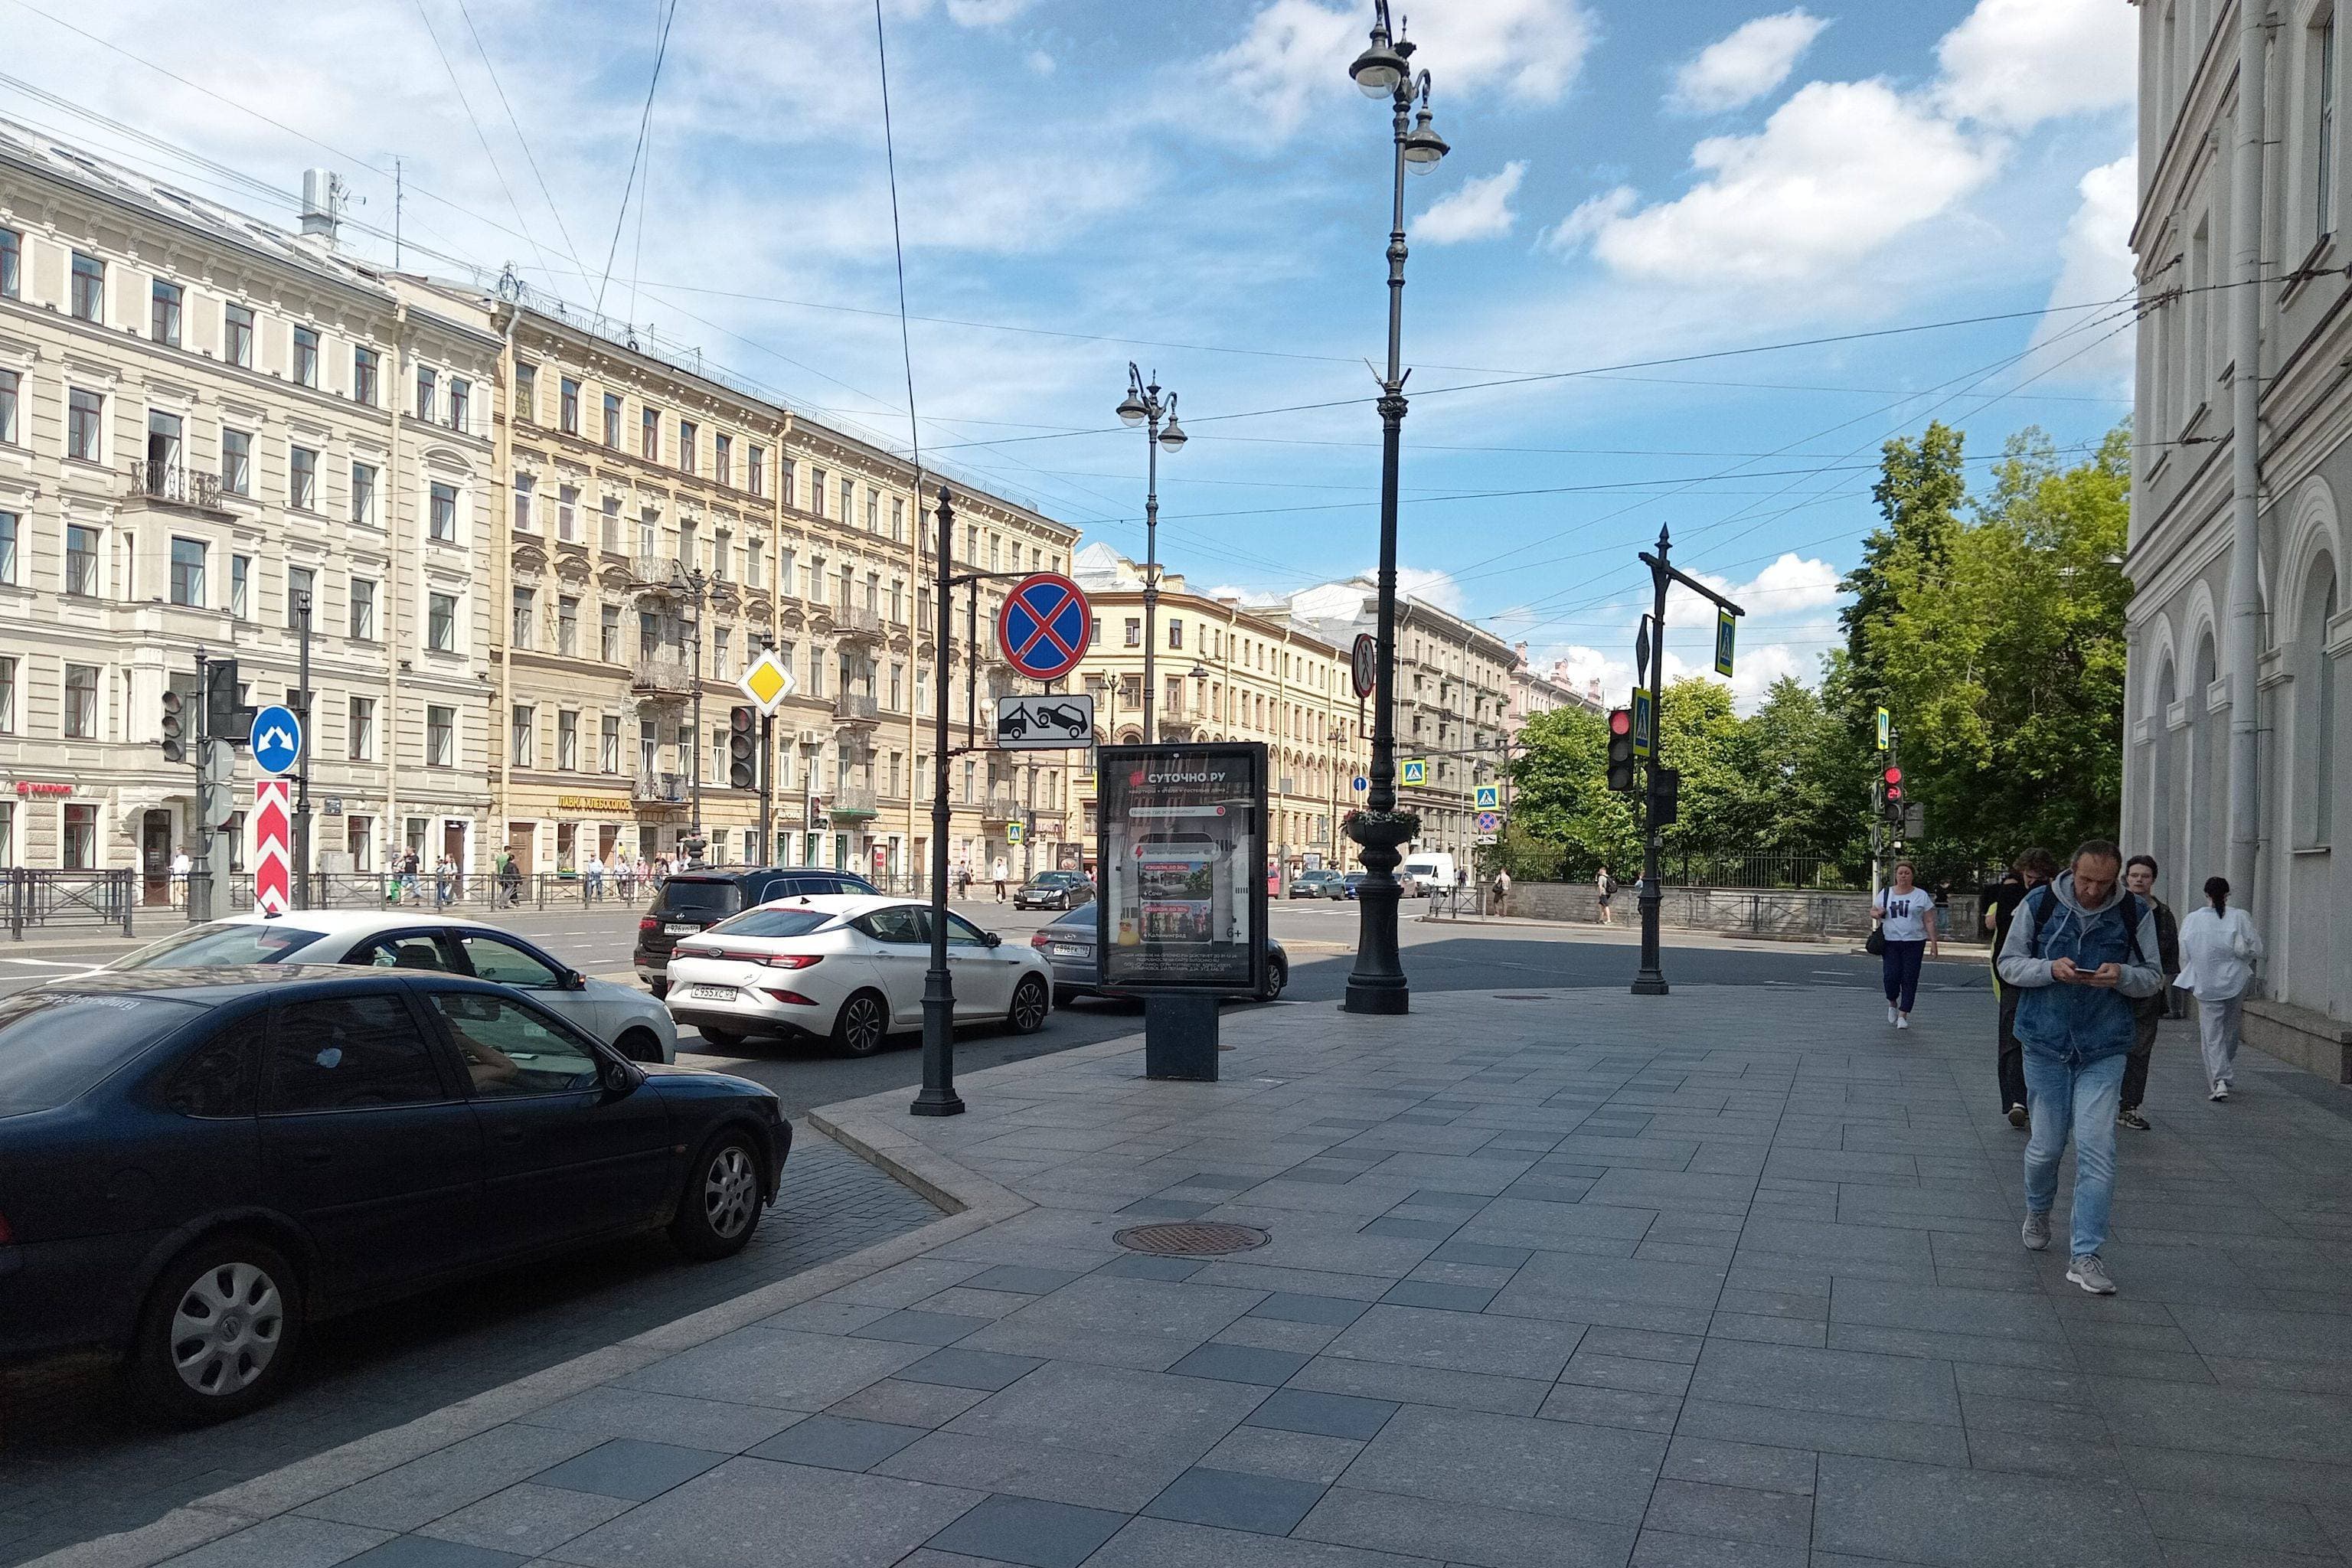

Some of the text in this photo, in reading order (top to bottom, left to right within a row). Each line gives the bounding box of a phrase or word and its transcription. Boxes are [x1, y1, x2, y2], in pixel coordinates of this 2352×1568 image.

[1888, 789, 1900, 799] 24
[559, 796, 630, 809] ЛАВКА ХЛЕБОСОЛОВ
[1890, 900, 1910, 918] Hi
[1227, 927, 1241, 937] 6+
